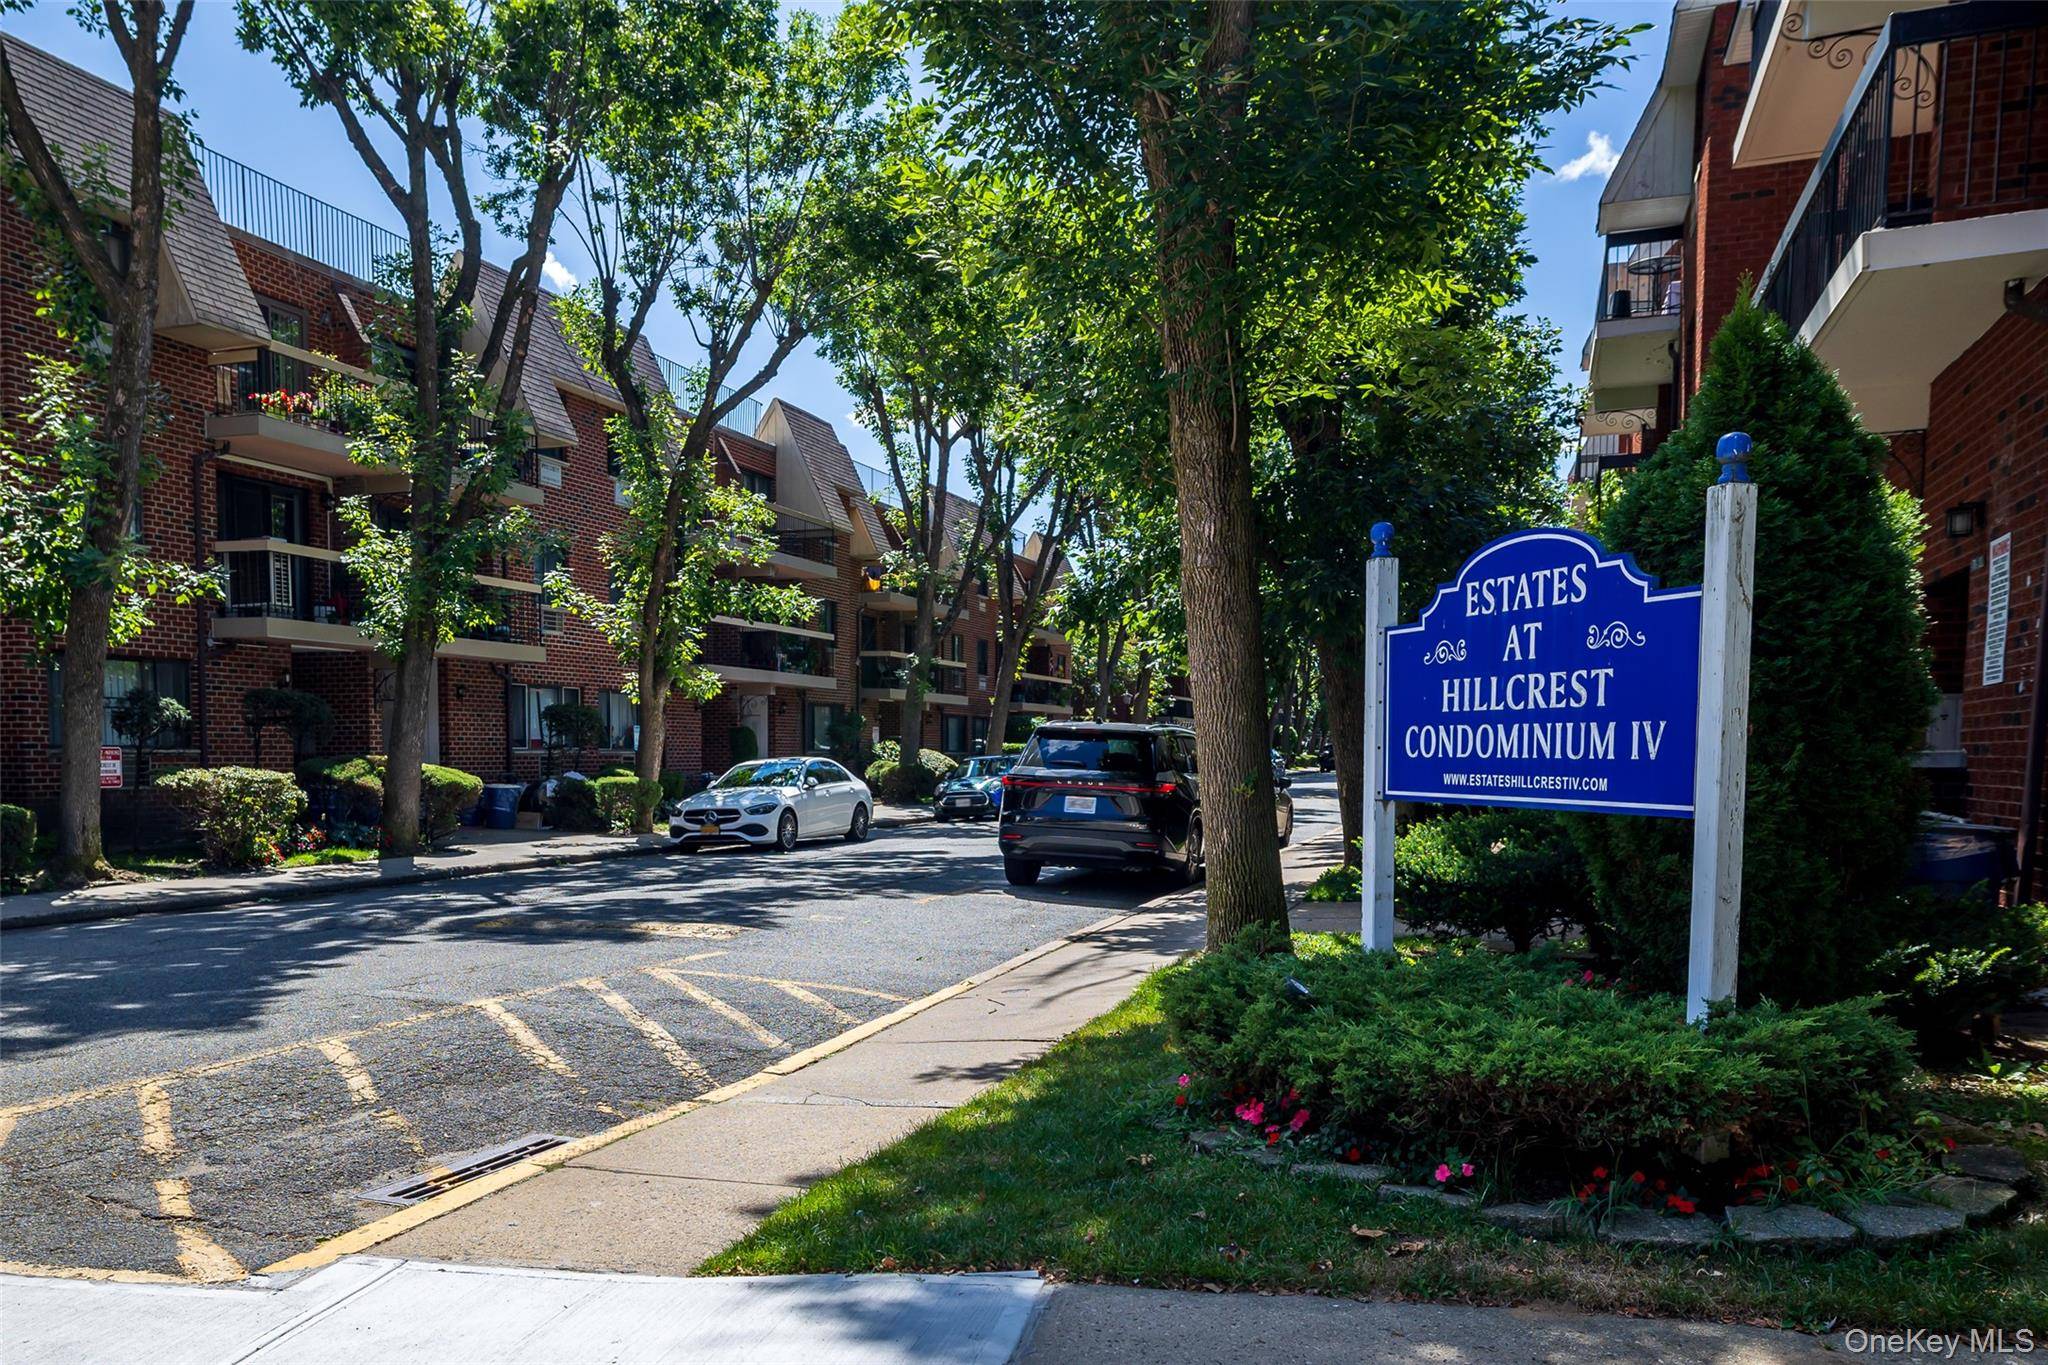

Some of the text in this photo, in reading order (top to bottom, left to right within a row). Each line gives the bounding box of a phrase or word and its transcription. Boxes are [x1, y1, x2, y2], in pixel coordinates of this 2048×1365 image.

[1465, 563, 1588, 617] ESTATES
[1502, 621, 1543, 662] AT
[1441, 668, 1614, 713] HILLCREST
[1404, 720, 1668, 761] CONDOMINIUM IV
[1443, 773, 1608, 791] WWW.ESTATESHILLCRESTIV.COM
